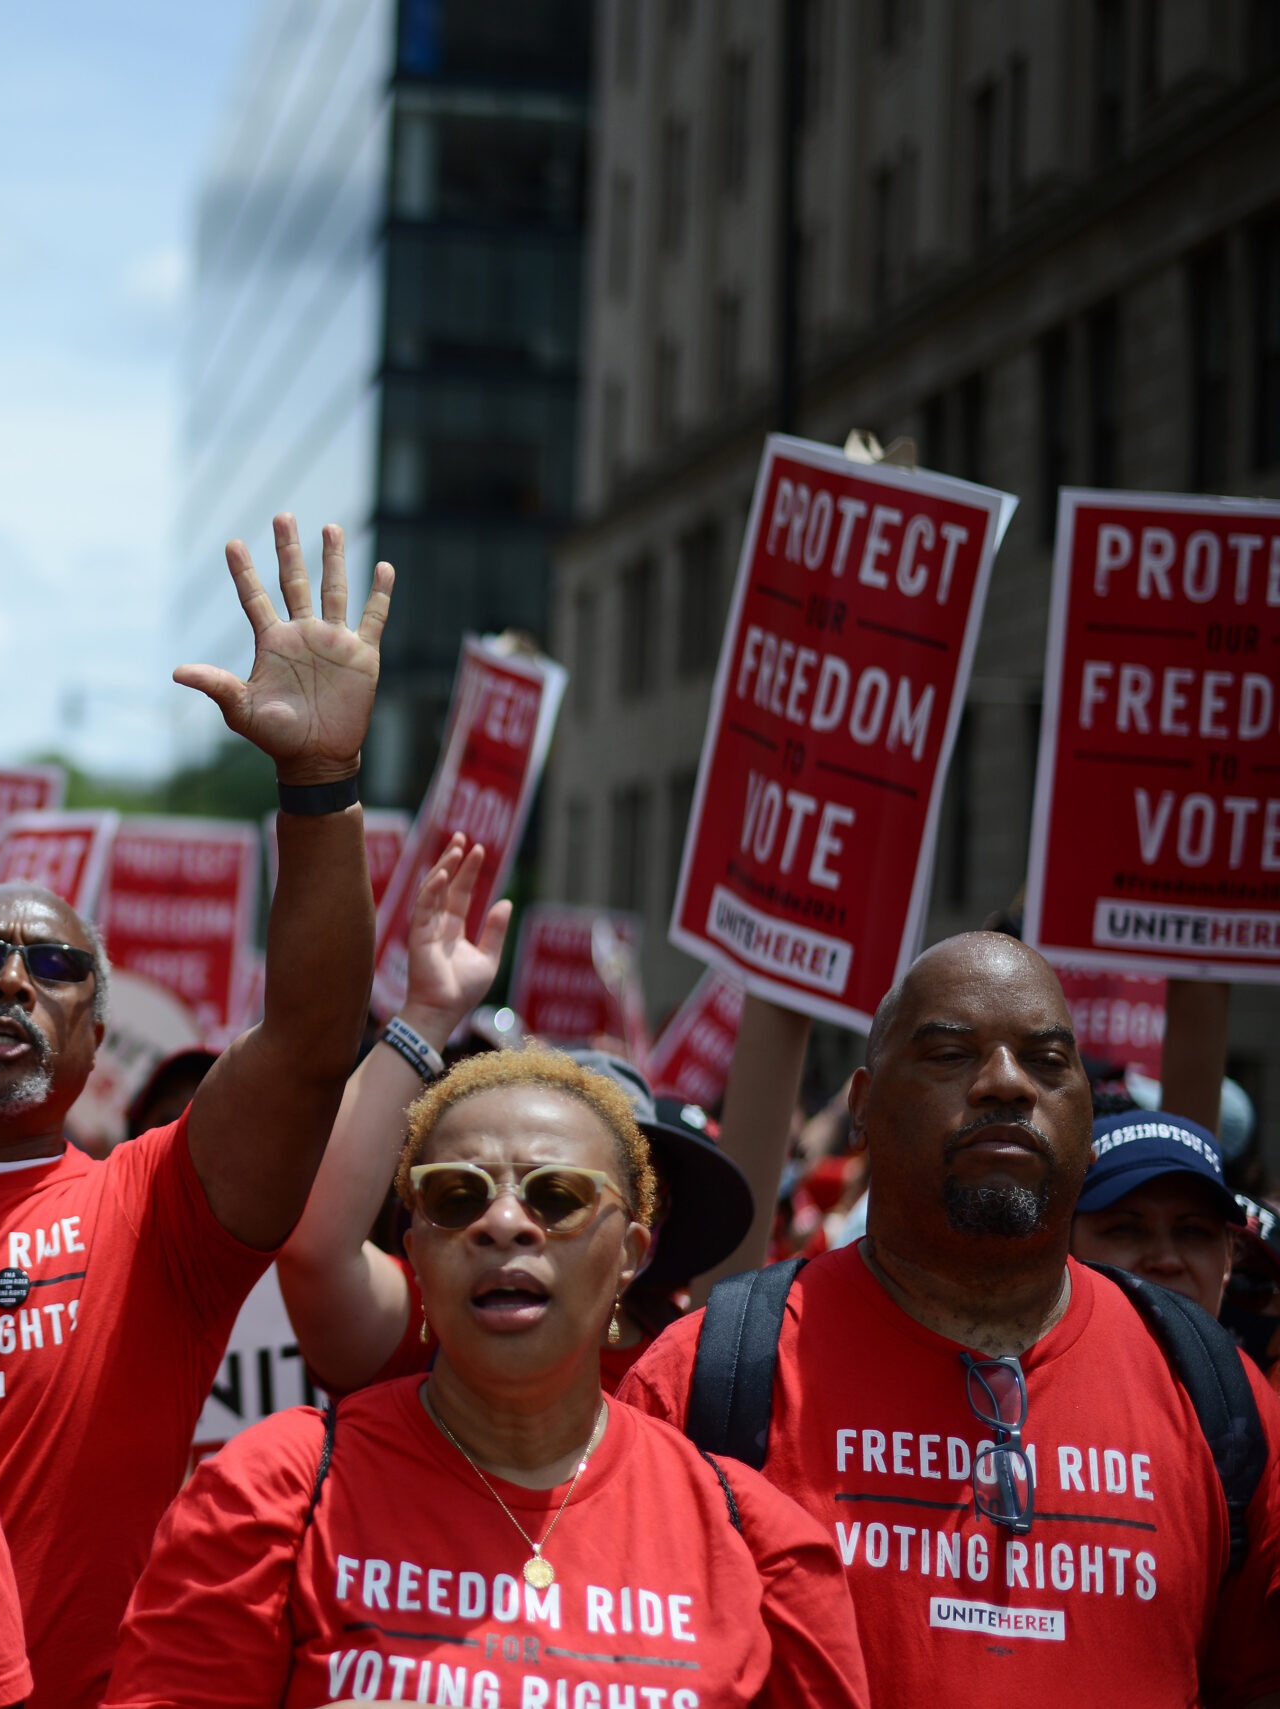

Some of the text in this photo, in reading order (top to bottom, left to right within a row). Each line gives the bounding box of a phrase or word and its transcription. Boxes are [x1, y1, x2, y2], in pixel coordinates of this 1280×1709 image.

[766, 477, 969, 605] PROTECT
[1206, 627, 1260, 654] OUR
[735, 625, 936, 763] FREEDOM
[1207, 753, 1238, 783] TO
[739, 769, 856, 891] VOTE
[1134, 787, 1280, 872] VOTE
[836, 1428, 1155, 1501] FREEDOM RIDE
[336, 1554, 697, 1642] FREEDOM RIDE
[835, 1521, 1157, 1601] VOTING RIGHTS
[484, 1632, 541, 1665] FOR
[937, 1603, 1056, 1633] UNITEHERE!
[328, 1649, 500, 1707] VOTING
